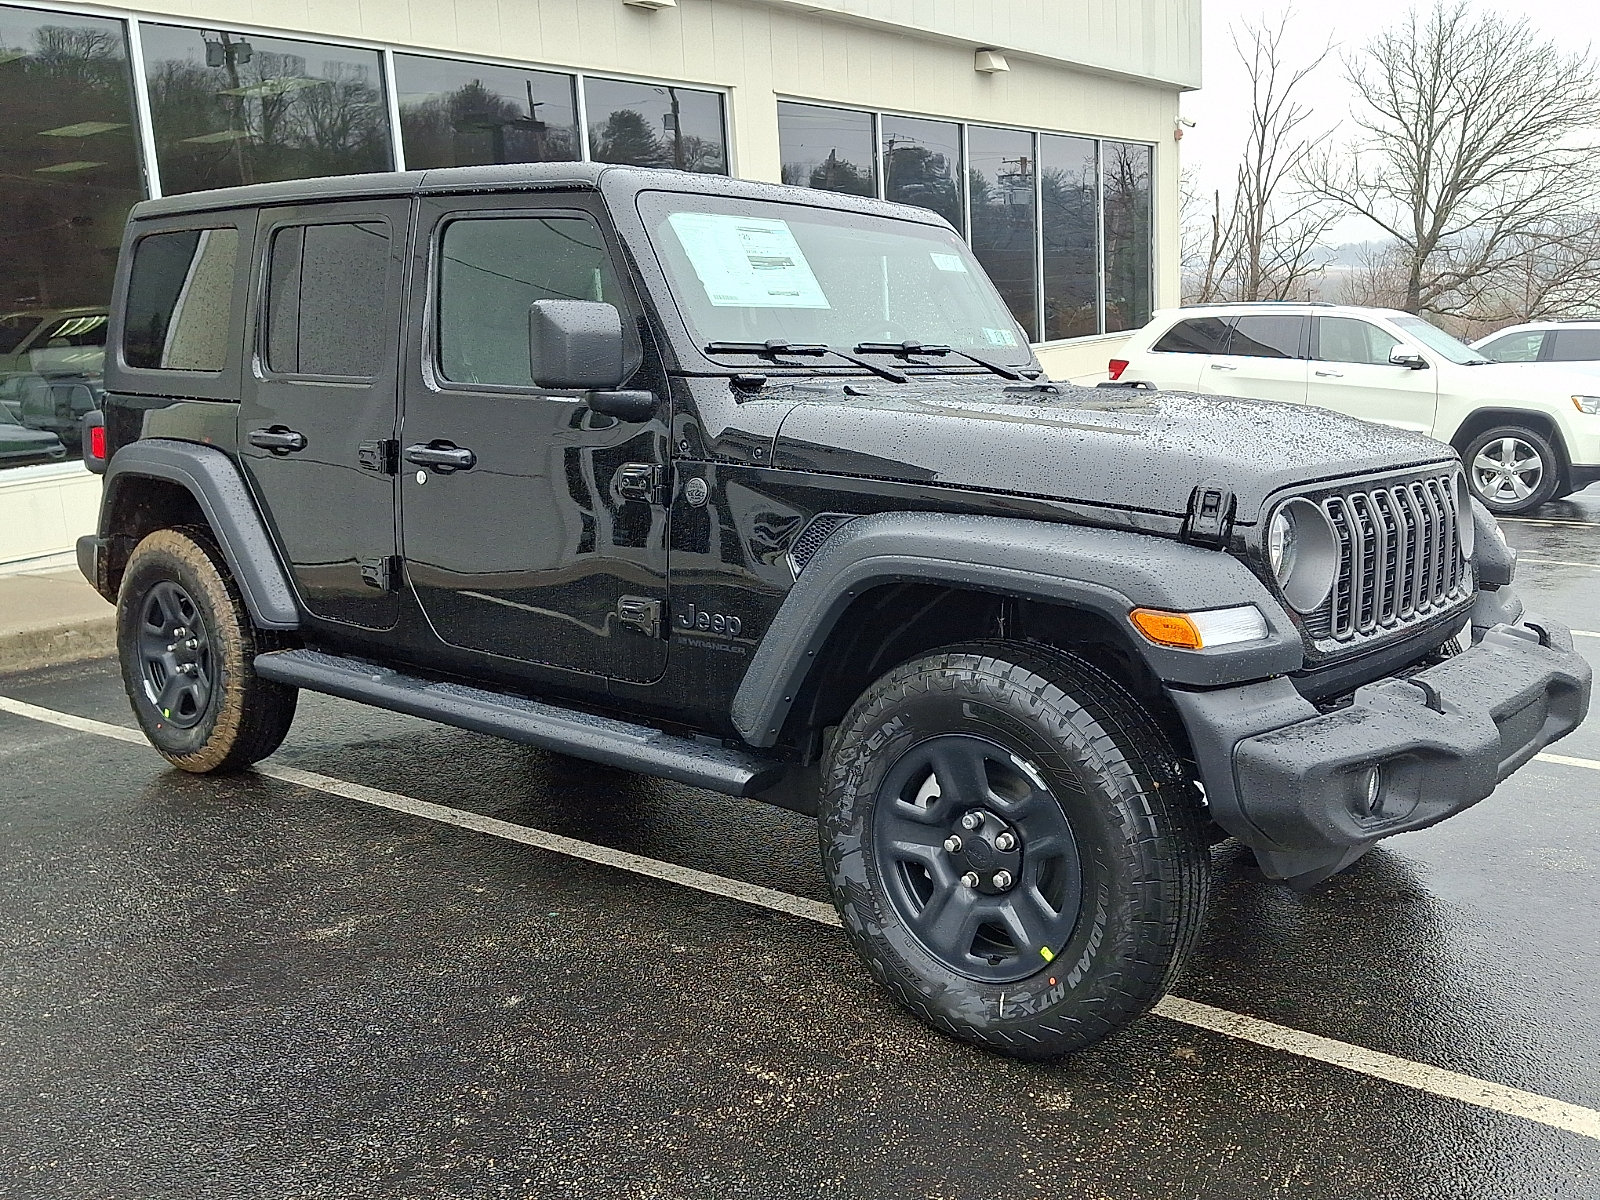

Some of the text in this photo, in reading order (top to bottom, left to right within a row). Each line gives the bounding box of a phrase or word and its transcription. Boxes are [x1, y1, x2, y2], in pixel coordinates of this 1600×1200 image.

[678, 603, 742, 641] Jeep
[688, 638, 747, 656] WRANGLER
[840, 716, 904, 821] NEXEN
